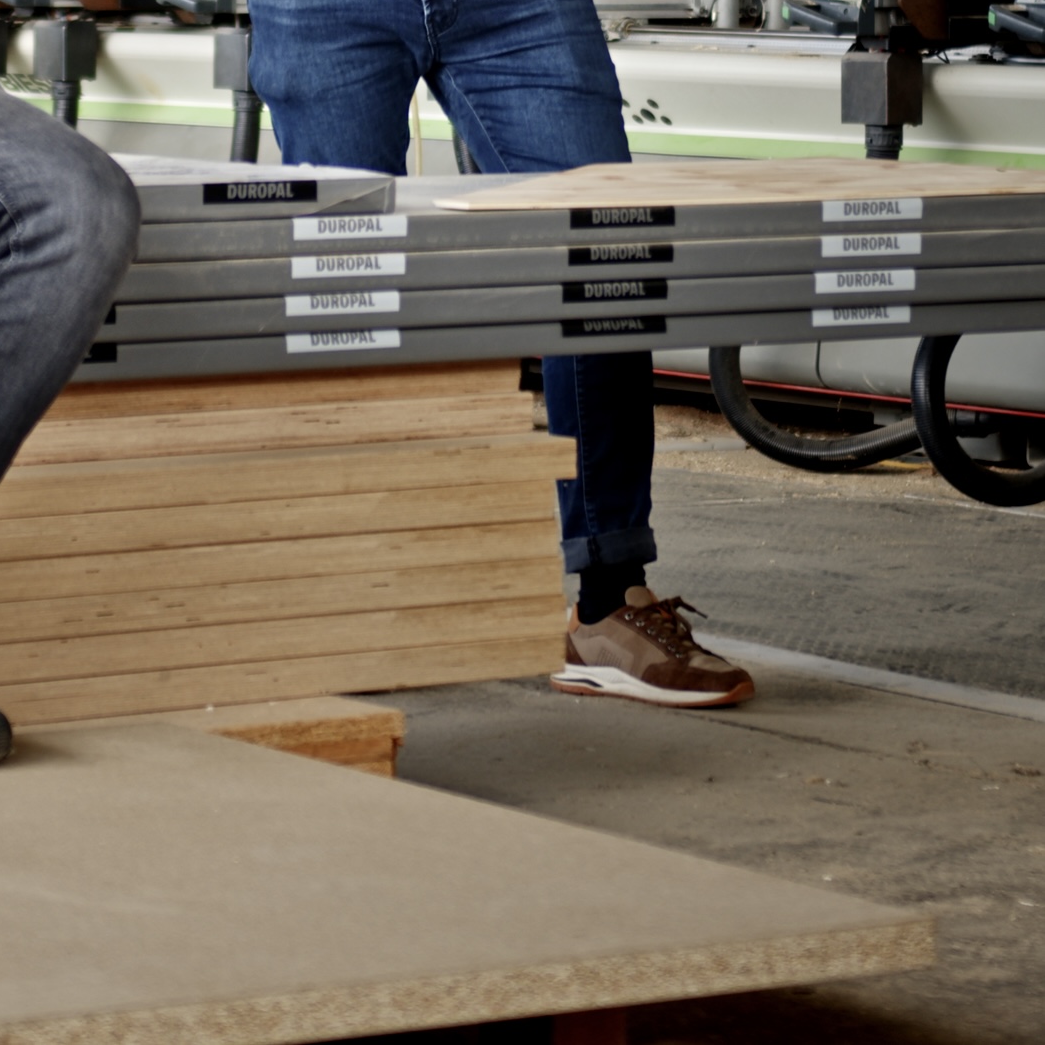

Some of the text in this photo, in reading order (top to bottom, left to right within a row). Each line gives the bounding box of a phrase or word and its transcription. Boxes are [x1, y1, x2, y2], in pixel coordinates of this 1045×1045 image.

[227, 181, 294, 199] DUROPAL
[592, 207, 653, 224] DUROPAL
[844, 201, 901, 216] DUROPAL
[317, 215, 383, 234] DUROPAL
[843, 236, 900, 252] DUROPAL
[590, 245, 652, 262] DUROPAL
[316, 255, 381, 273] DUROPAL
[836, 272, 894, 288] DUROPAL
[584, 282, 646, 298] DUROPAL
[310, 293, 376, 310] DUROPAL
[833, 306, 890, 321] DUROPAL
[310, 331, 376, 346] DUROPAL
